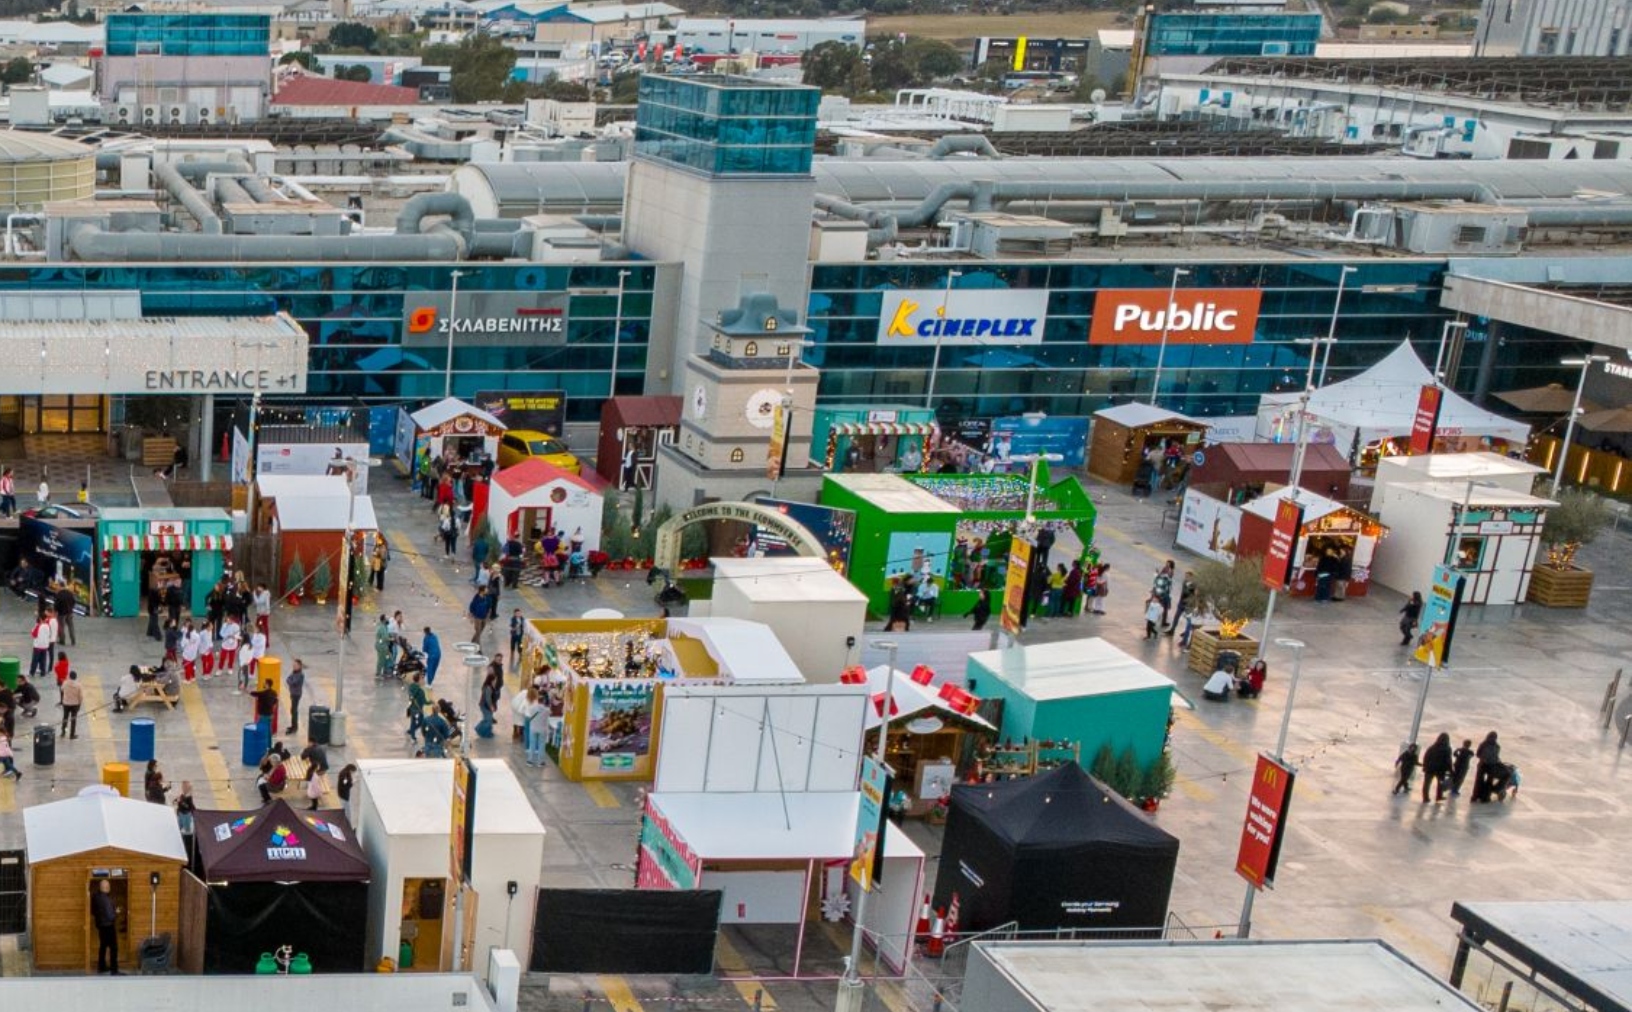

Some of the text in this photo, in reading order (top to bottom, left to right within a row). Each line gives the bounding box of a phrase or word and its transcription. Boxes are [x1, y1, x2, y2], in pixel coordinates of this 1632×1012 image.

[1113, 302, 1238, 331] Public
[438, 318, 562, 333] ΣΚΛΑΒΕΝΙΤΗΣ
[145, 370, 297, 389] ENTRANCE +1
[683, 507, 718, 522] WELCOME
[722, 507, 731, 515] TO
[736, 508, 749, 518] THE
